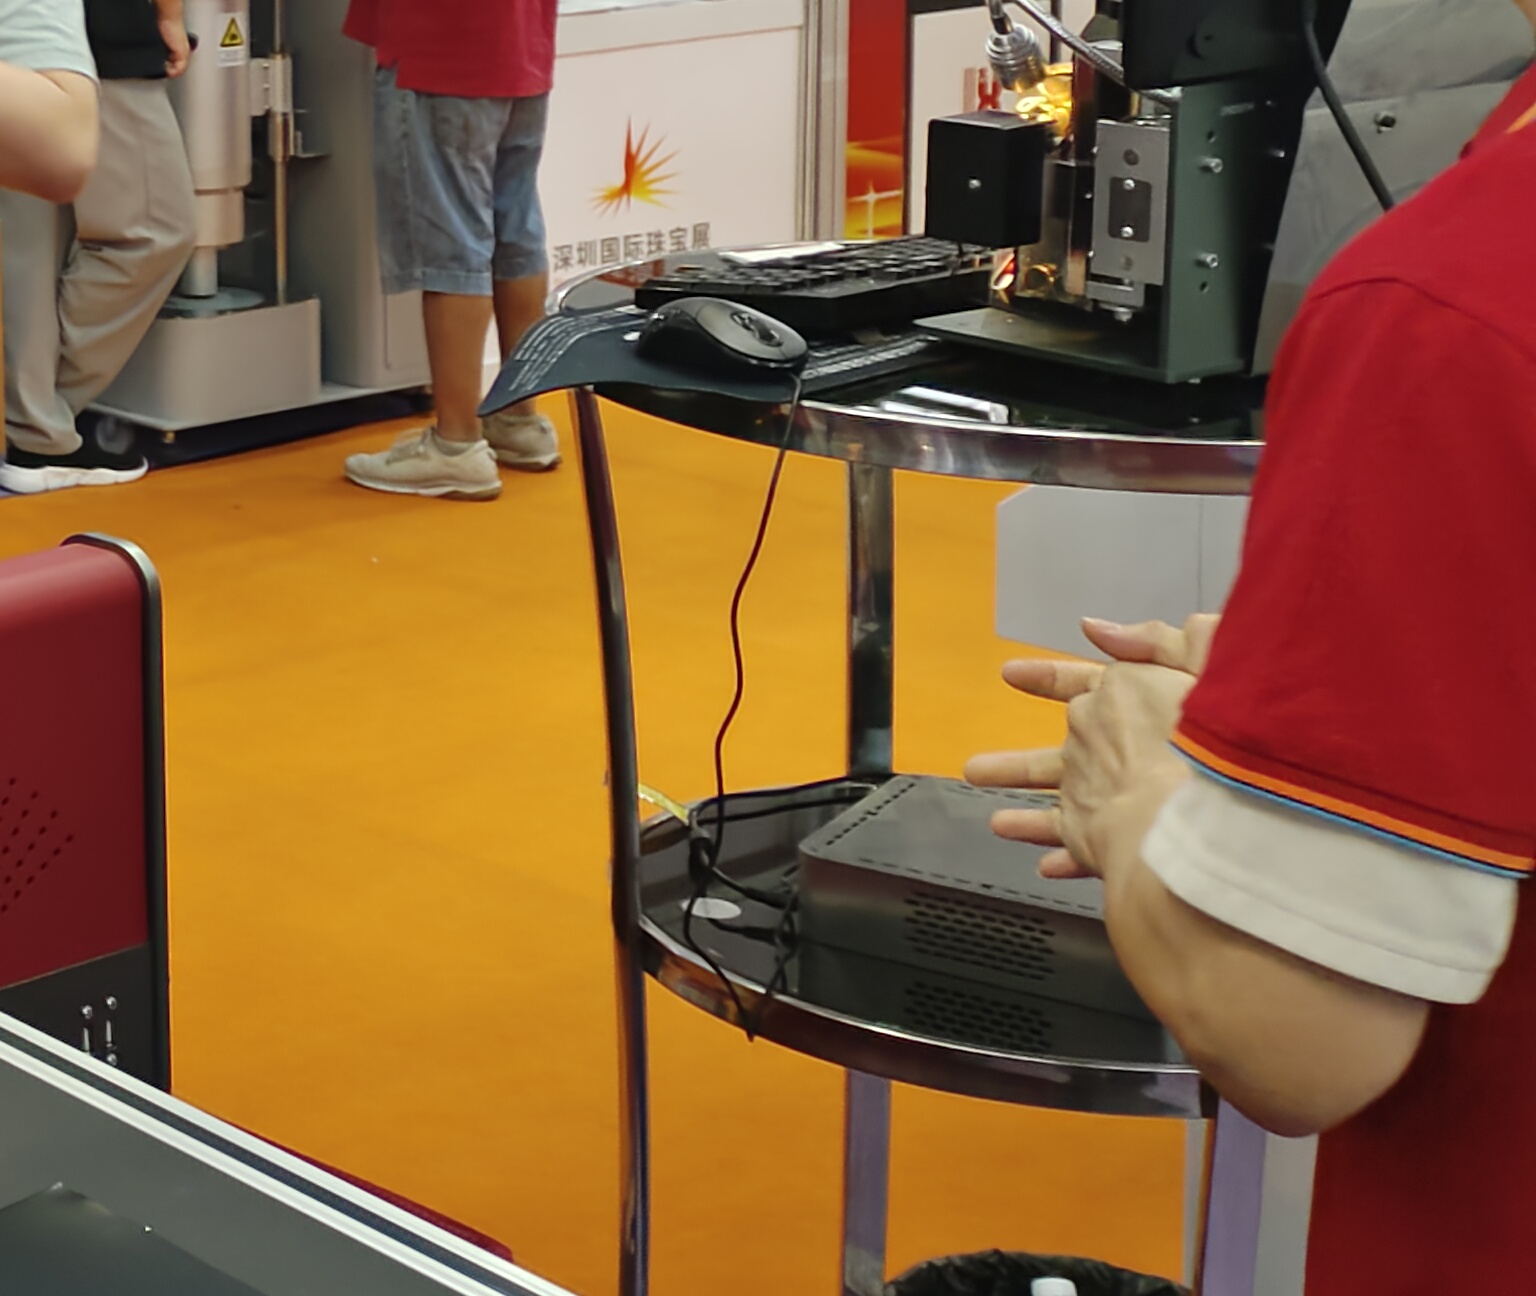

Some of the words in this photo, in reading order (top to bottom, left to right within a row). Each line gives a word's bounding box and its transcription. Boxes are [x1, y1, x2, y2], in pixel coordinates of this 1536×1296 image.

[552, 221, 712, 273] 深圳国际珠宝展
